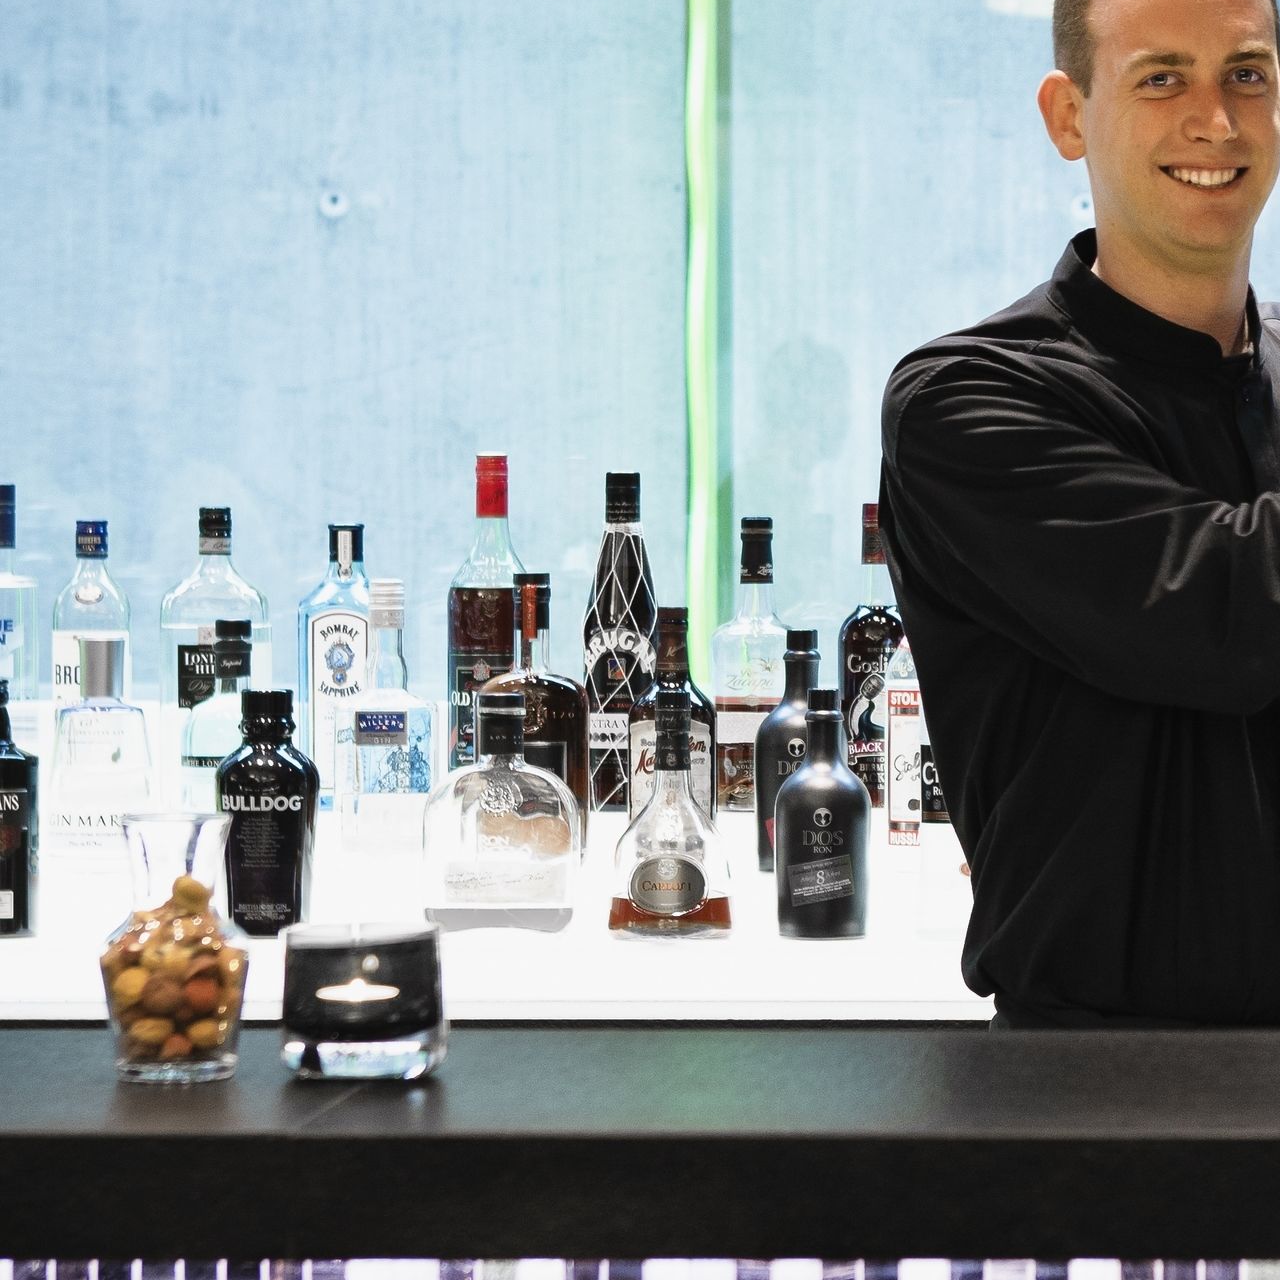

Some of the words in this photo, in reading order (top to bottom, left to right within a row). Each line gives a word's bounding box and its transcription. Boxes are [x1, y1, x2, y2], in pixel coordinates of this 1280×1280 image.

[318, 681, 361, 698] SAPPHIRE
[451, 691, 470, 706] OLD
[848, 742, 882, 755] BLACK
[221, 795, 302, 811] BULLDOG
[802, 830, 844, 846] DOS
[816, 870, 825, 884] 8
